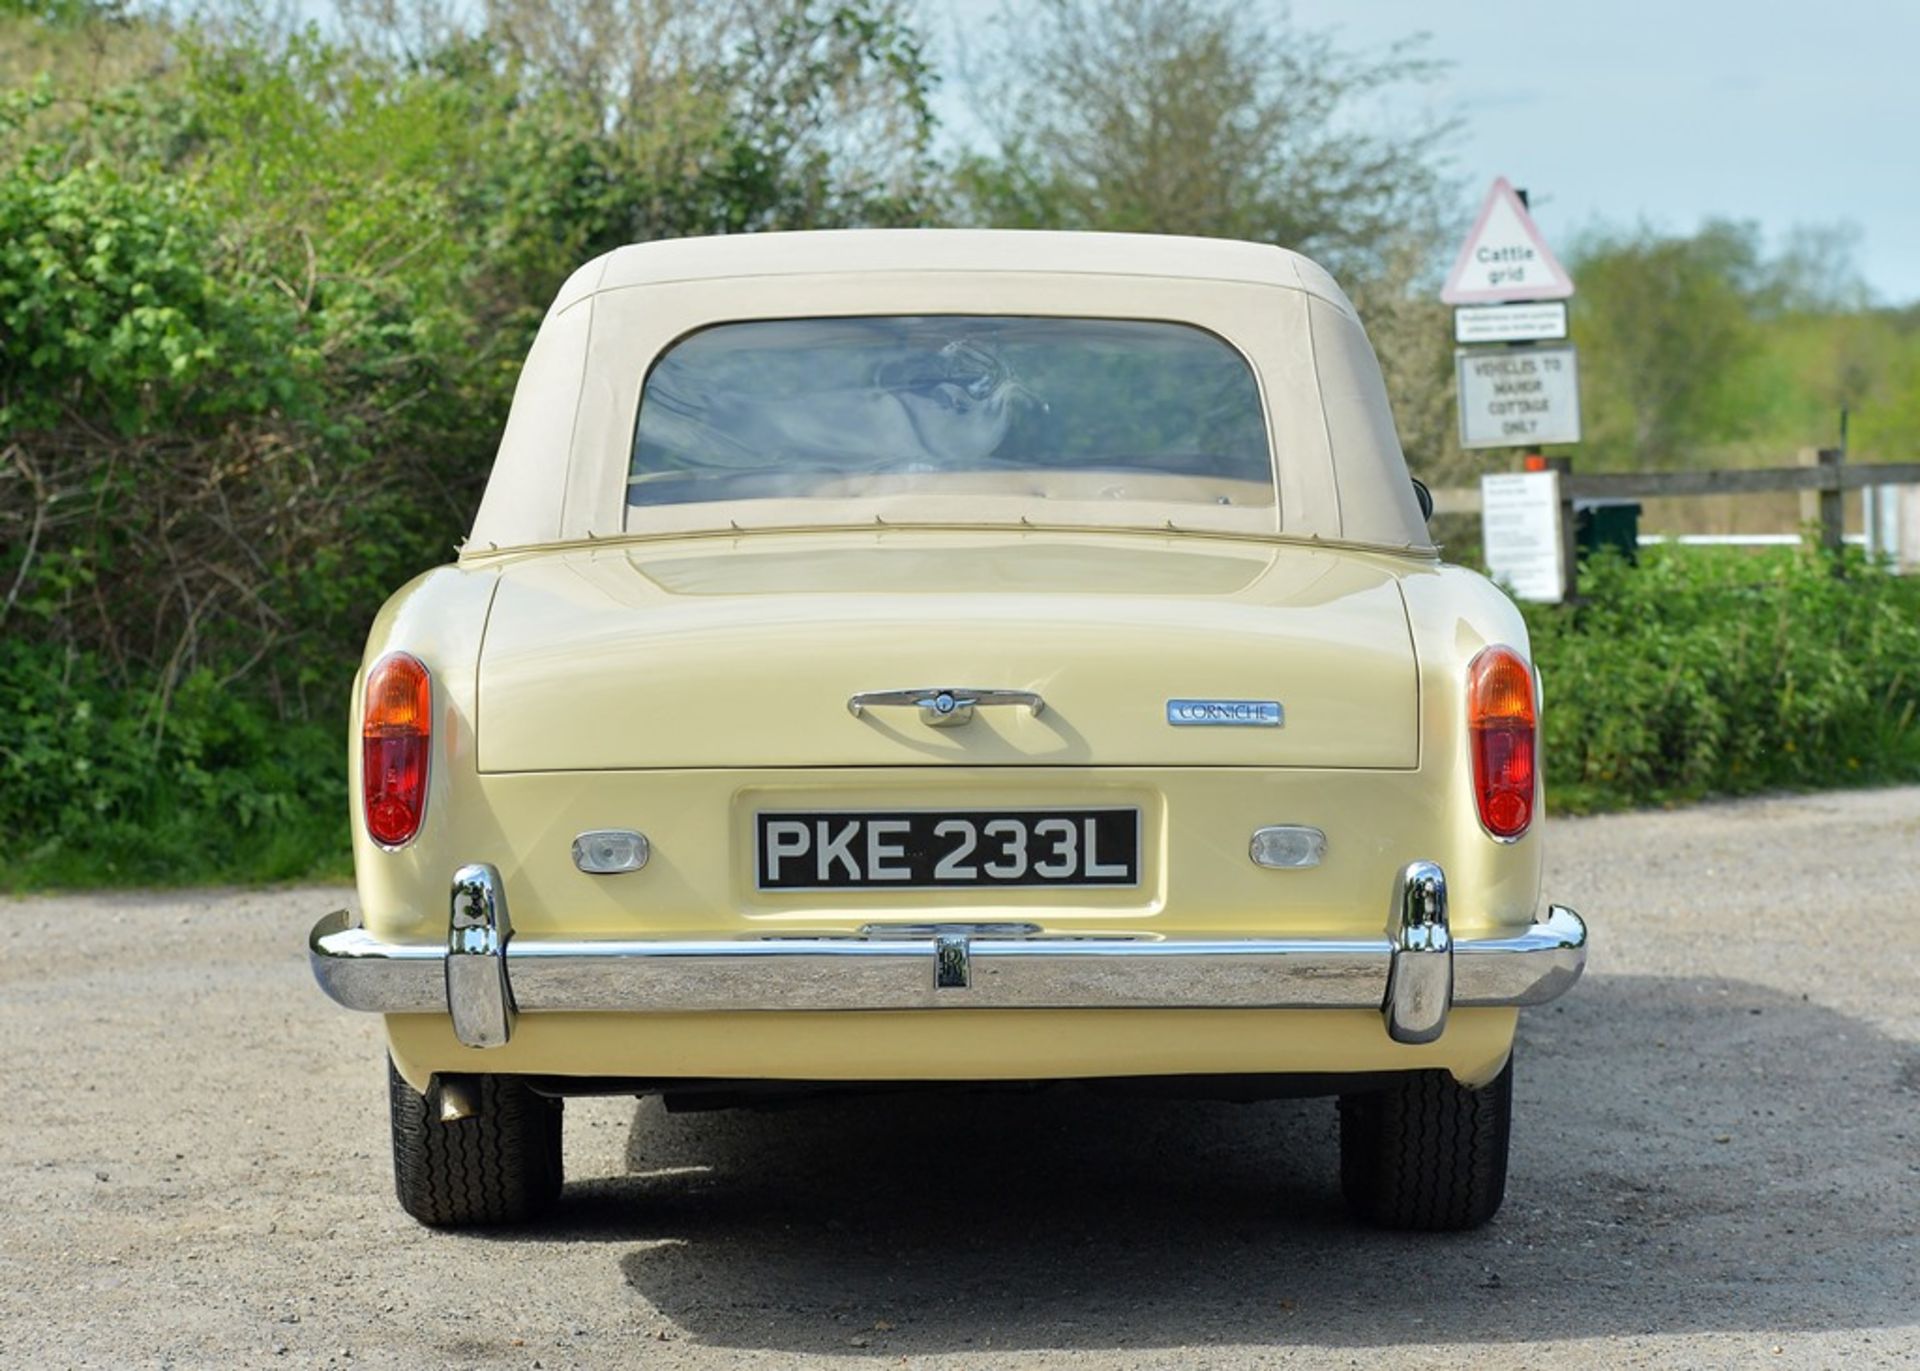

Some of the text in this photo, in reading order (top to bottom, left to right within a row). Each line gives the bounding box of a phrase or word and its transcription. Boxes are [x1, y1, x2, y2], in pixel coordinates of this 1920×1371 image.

[1476, 245, 1535, 263] Cattle
[1487, 266, 1525, 286] grid
[1474, 358, 1562, 377] VEHICLES TO
[1487, 399, 1550, 415] COTTAGE
[1502, 419, 1539, 435] ONLY
[1179, 704, 1268, 721] CORNICHE
[766, 818, 1128, 881] PKE 233L
